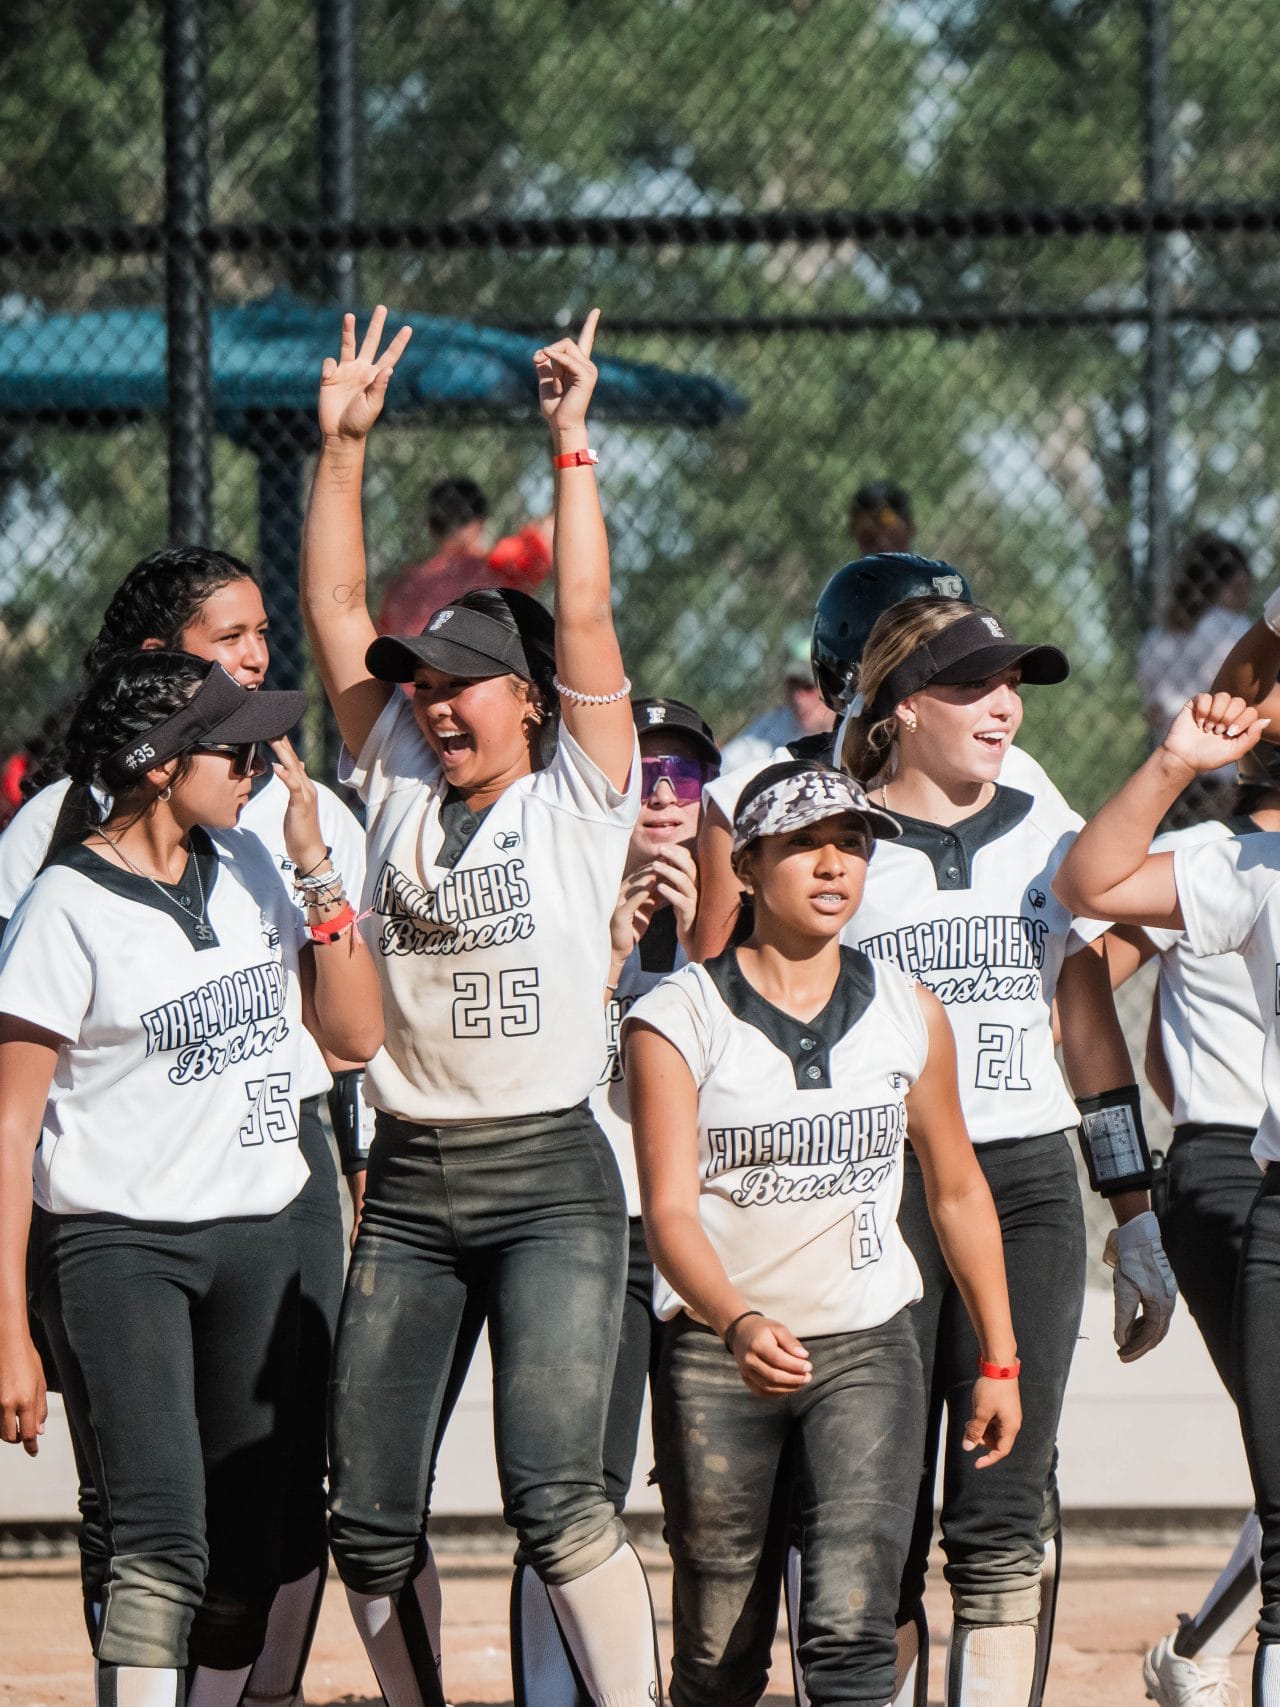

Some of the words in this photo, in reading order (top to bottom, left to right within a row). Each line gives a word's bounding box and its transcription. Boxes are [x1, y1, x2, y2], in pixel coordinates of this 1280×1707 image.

[125, 742, 156, 770] #35
[379, 912, 535, 957] Brashear
[140, 960, 286, 1058] FIRECRACKER
[452, 966, 540, 1039] 25
[911, 970, 1041, 1006] ashear
[974, 1022, 1032, 1091] 21
[239, 1071, 299, 1148] 35
[730, 1159, 896, 1209] Brashea
[849, 1200, 883, 1271] 8
